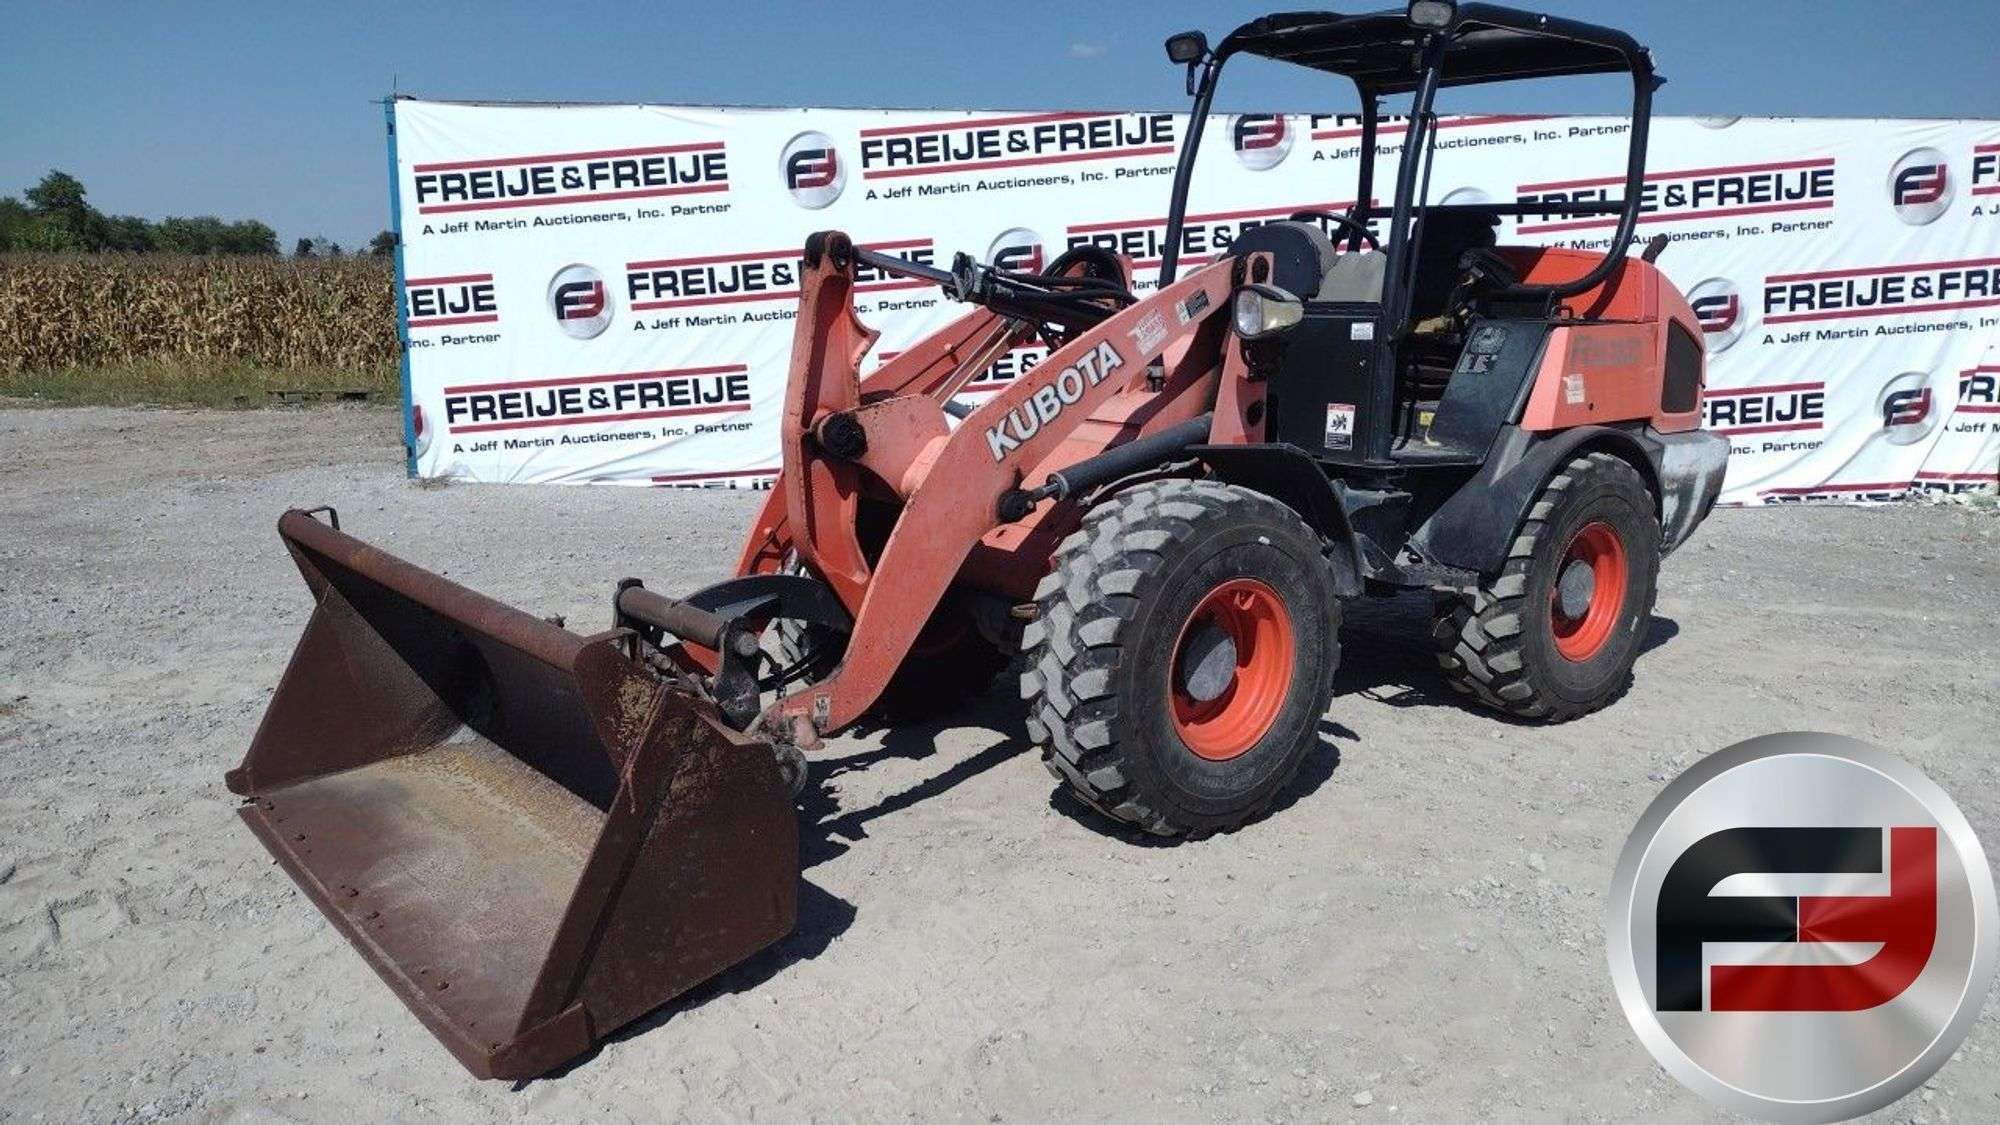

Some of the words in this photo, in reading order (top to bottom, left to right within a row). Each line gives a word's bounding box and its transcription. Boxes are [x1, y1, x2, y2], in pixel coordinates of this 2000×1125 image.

[1313, 150, 1325, 161] A
[1330, 146, 1361, 159] Jeff
[1534, 128, 1561, 141] Inc.
[1569, 123, 1630, 138] Partner
[866, 189, 878, 200] A
[883, 186, 912, 199] Jeff
[918, 182, 970, 196] Martin
[976, 174, 1075, 191] Auctioneers,
[1081, 170, 1108, 182] Inc.
[1115, 164, 1177, 178] Partner
[422, 225, 435, 236] A
[440, 221, 469, 234] Jeff
[475, 216, 527, 231] Martin
[533, 210, 632, 228] Auctioneers,
[637, 206, 665, 219] Inc.
[671, 202, 731, 216] Partner
[1737, 224, 1764, 237] Inc.
[1772, 218, 1834, 233] Partner
[633, 320, 645, 332] A
[651, 316, 681, 330] Jeff
[686, 313, 737, 327] Martin
[878, 299, 938, 311] Partner
[441, 333, 500, 347] Partner
[1762, 334, 1775, 345] A
[1781, 331, 1810, 344] Jeff
[1816, 328, 1869, 341] Martin
[1875, 320, 1973, 336] Auctioneers,
[985, 338, 1125, 463] KUBOTA
[452, 443, 465, 453] A
[470, 439, 498, 452] Jeff
[504, 435, 555, 449] Martin
[560, 428, 657, 445] Auctioneers,
[662, 426, 690, 437] Inc.
[695, 420, 753, 434] Partner
[1955, 422, 1986, 433] Jeff
[1762, 440, 1823, 453] Partner
